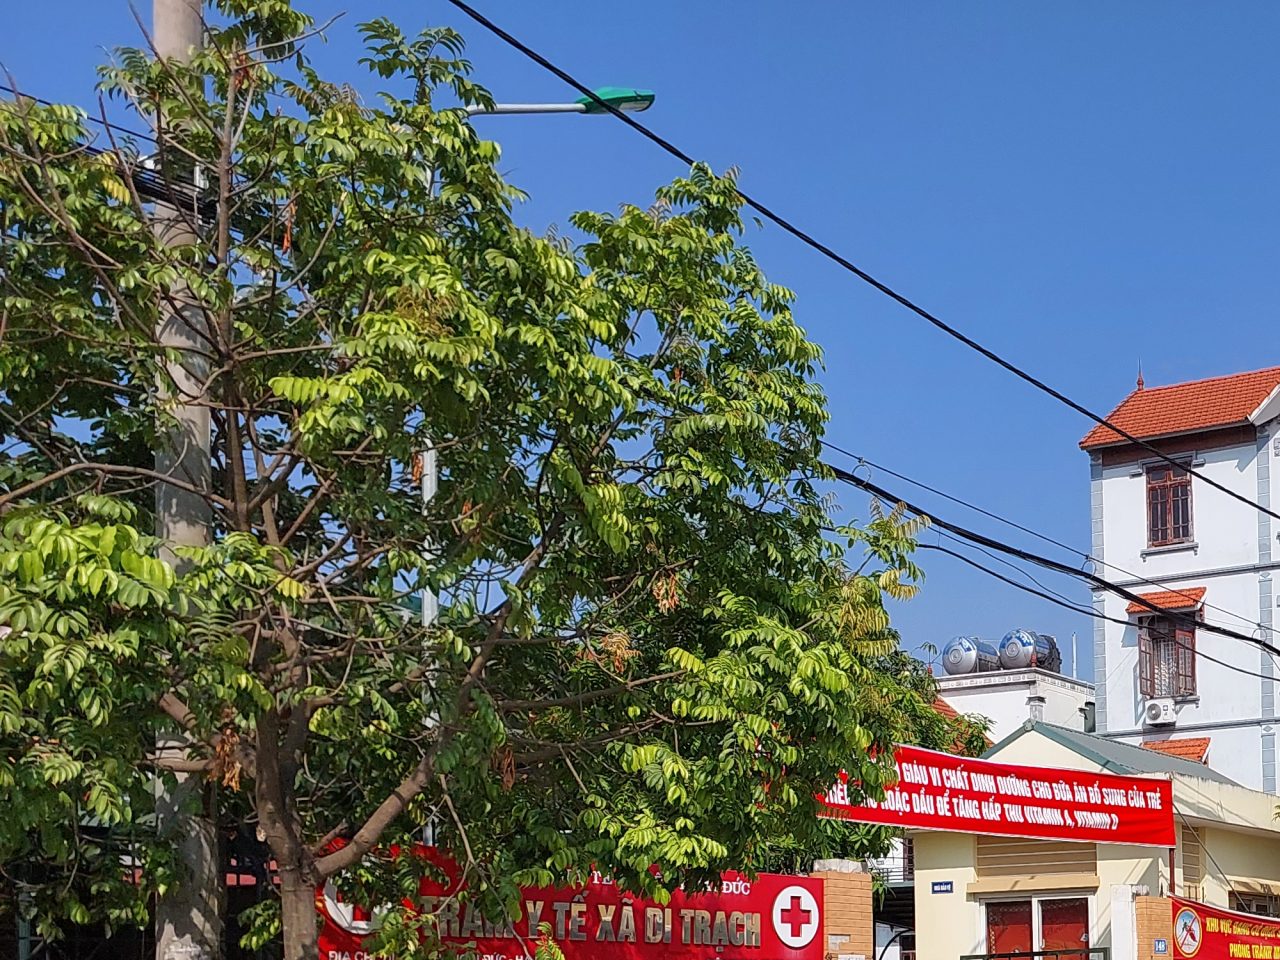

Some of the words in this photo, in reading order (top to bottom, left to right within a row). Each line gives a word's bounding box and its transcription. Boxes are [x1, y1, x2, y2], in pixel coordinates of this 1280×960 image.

[929, 767, 942, 787] VI
[942, 764, 970, 790] CHẤT
[970, 772, 997, 794] DINH
[997, 773, 1032, 798] DƯỠNG
[1032, 780, 1052, 800] CHO
[1052, 780, 1074, 802] BỮA
[1074, 782, 1088, 803] ĂN
[1088, 781, 1101, 804] BỔ
[1102, 788, 1128, 807] SUNG
[1128, 785, 1146, 808] CỦA
[1146, 788, 1162, 809] TRẺ
[912, 787, 934, 815] DẦU
[936, 790, 952, 817] ĐỂ
[952, 797, 981, 819] TĂNG
[981, 796, 1001, 821] HẤP
[1003, 803, 1025, 823] THU
[1024, 805, 1064, 827] VITAMIN
[1064, 813, 1075, 829] A,
[1074, 810, 1111, 830] VITAMIN
[1111, 813, 1119, 830] D
[722, 877, 750, 895] ĐỨC
[526, 901, 544, 938] Y
[553, 890, 587, 941] TẾ
[596, 898, 637, 943] XÃ
[645, 907, 671, 944] DI
[680, 910, 761, 952] TRẠCH
[1206, 917, 1219, 932] KHU
[1220, 919, 1232, 936] VỰC
[1229, 941, 1251, 958] PHÒNG
[1252, 943, 1272, 959] TRÁNH
